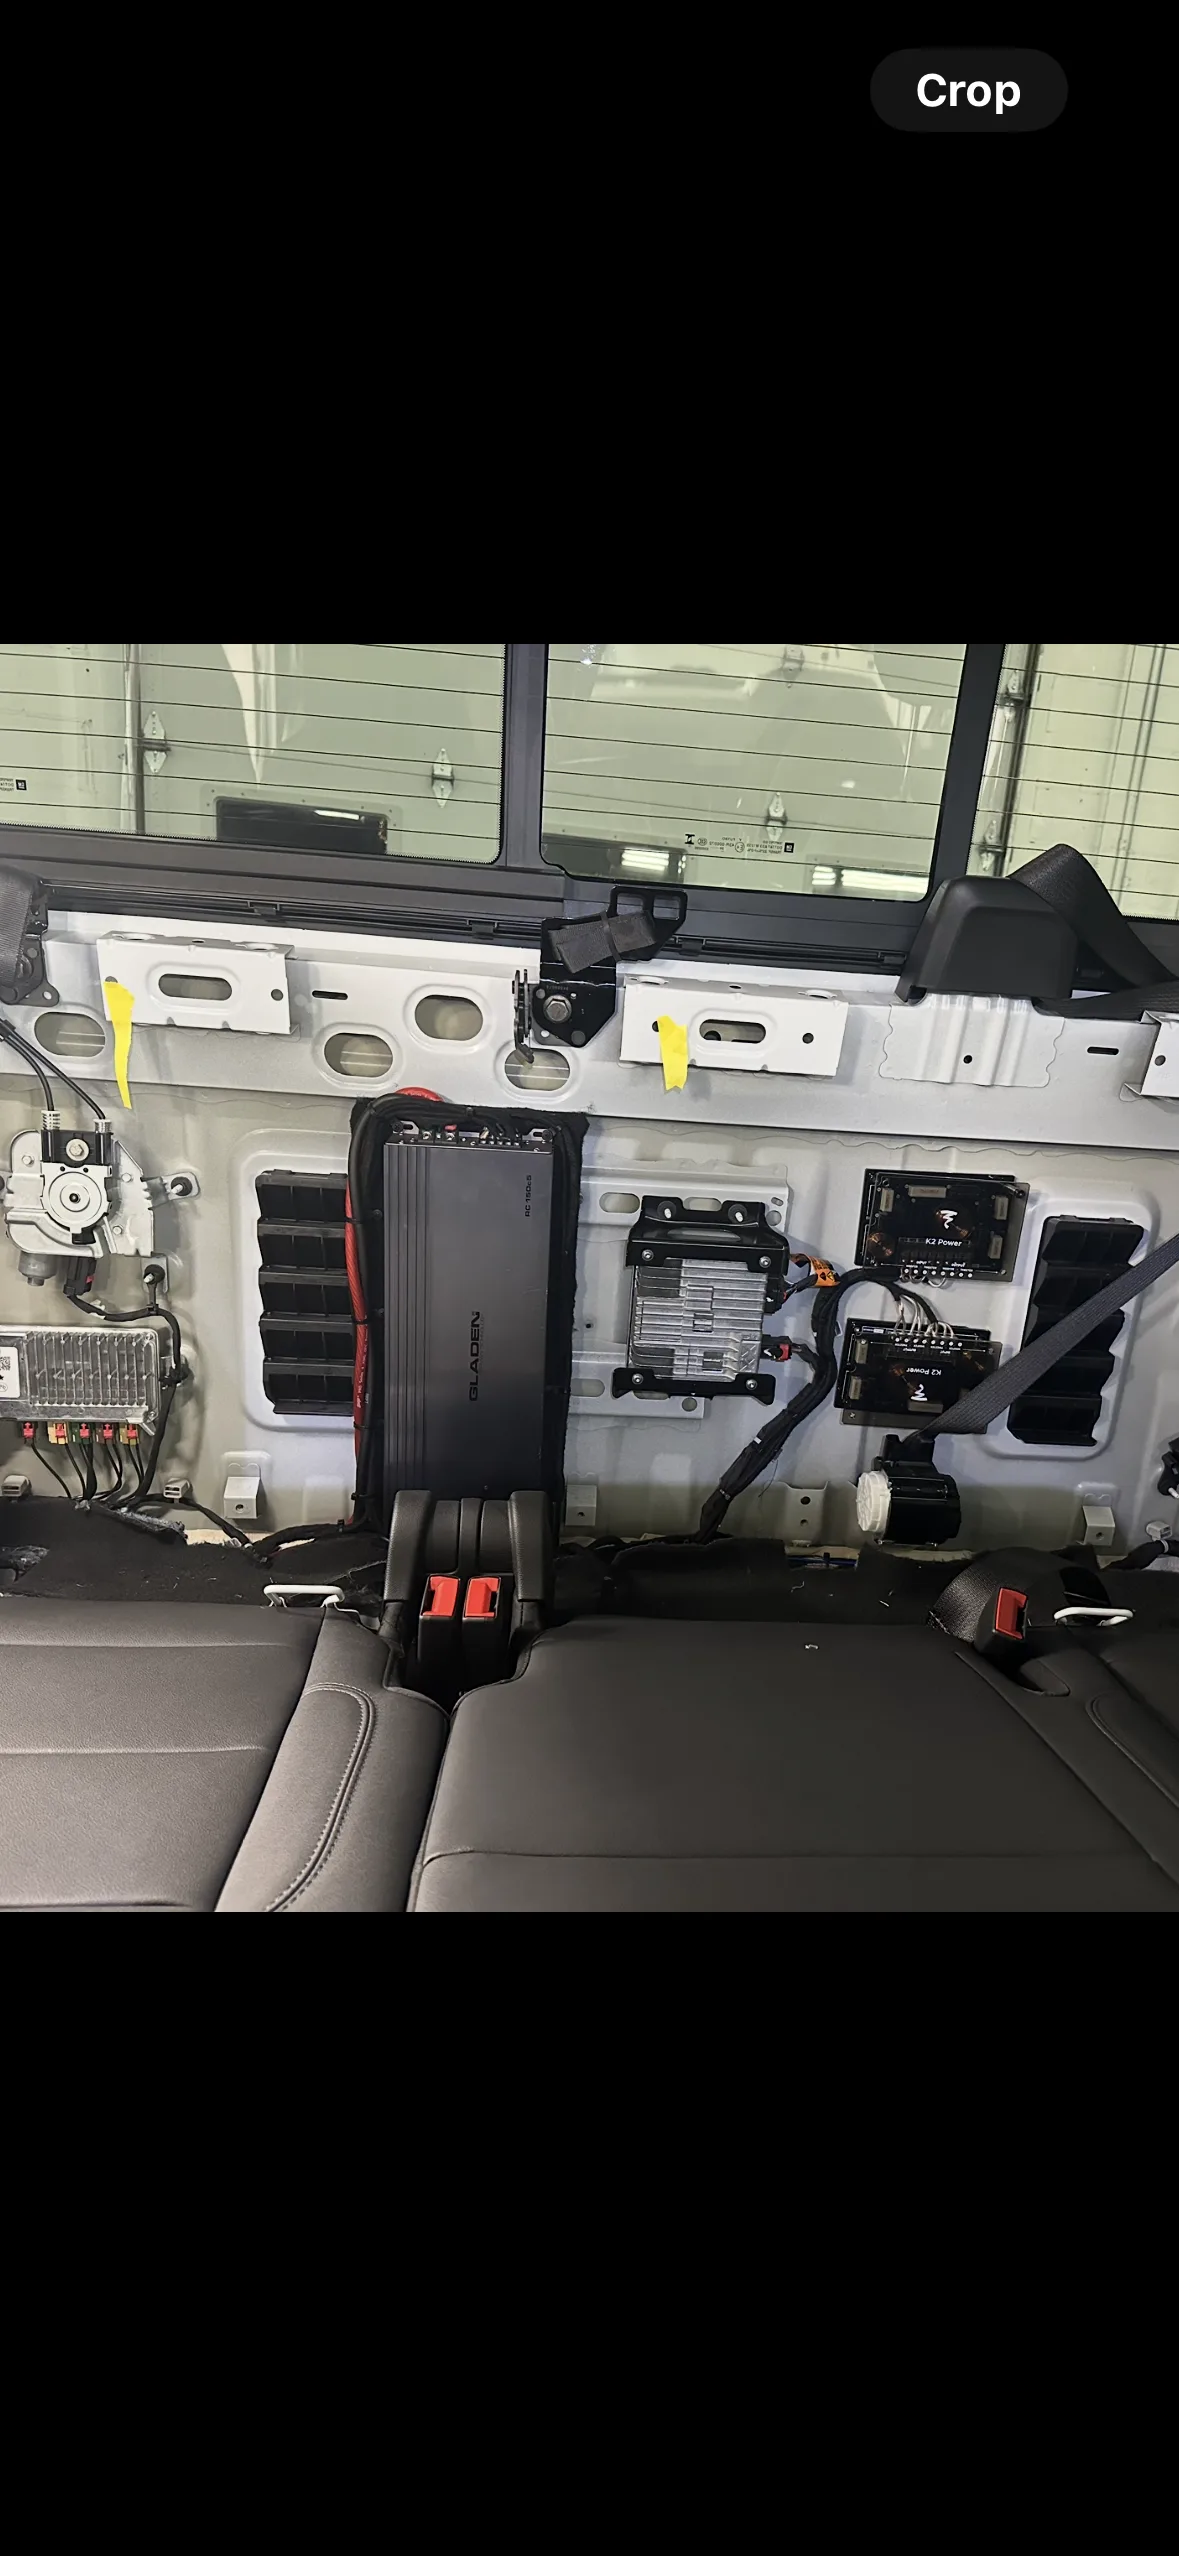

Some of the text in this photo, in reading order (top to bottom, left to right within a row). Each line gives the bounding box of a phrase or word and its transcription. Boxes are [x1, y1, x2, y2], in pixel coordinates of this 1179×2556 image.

[937, 1238, 962, 1247] Power
[469, 1311, 480, 1401] GLADEN
[906, 1367, 942, 1376] K2 Power
